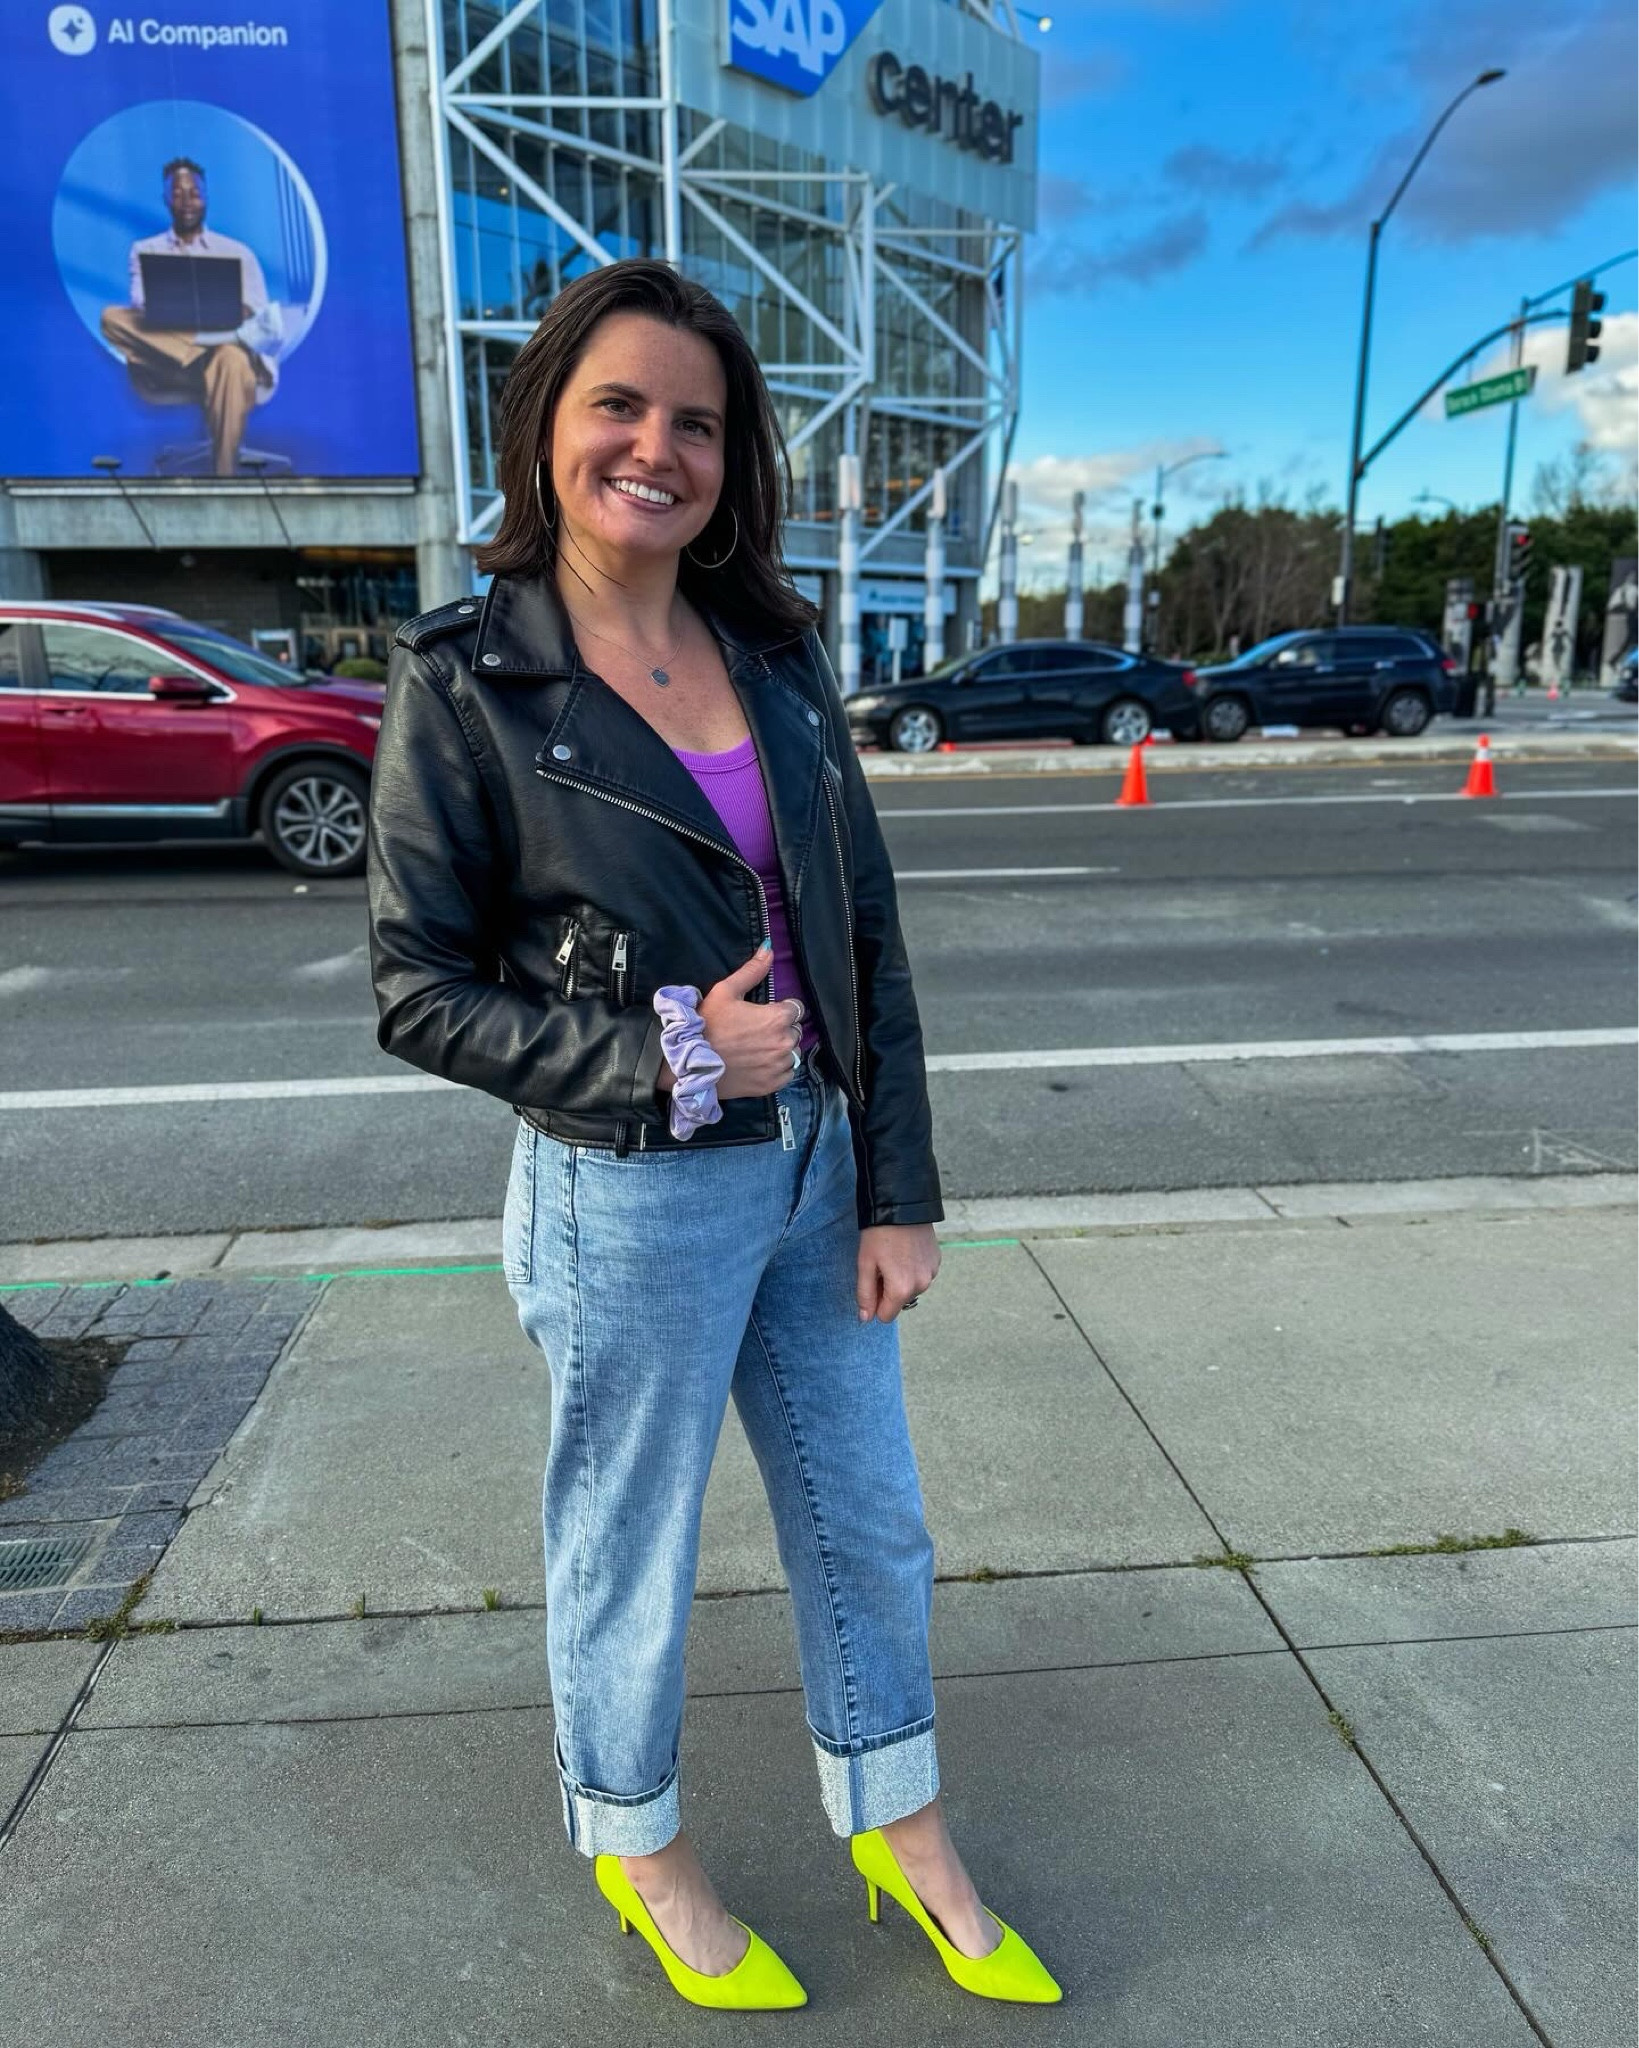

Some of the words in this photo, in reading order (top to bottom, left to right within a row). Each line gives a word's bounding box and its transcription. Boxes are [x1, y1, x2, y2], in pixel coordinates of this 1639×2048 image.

[108, 18, 134, 44] AI
[139, 18, 288, 50] Companion
[733, 0, 845, 76] SAP
